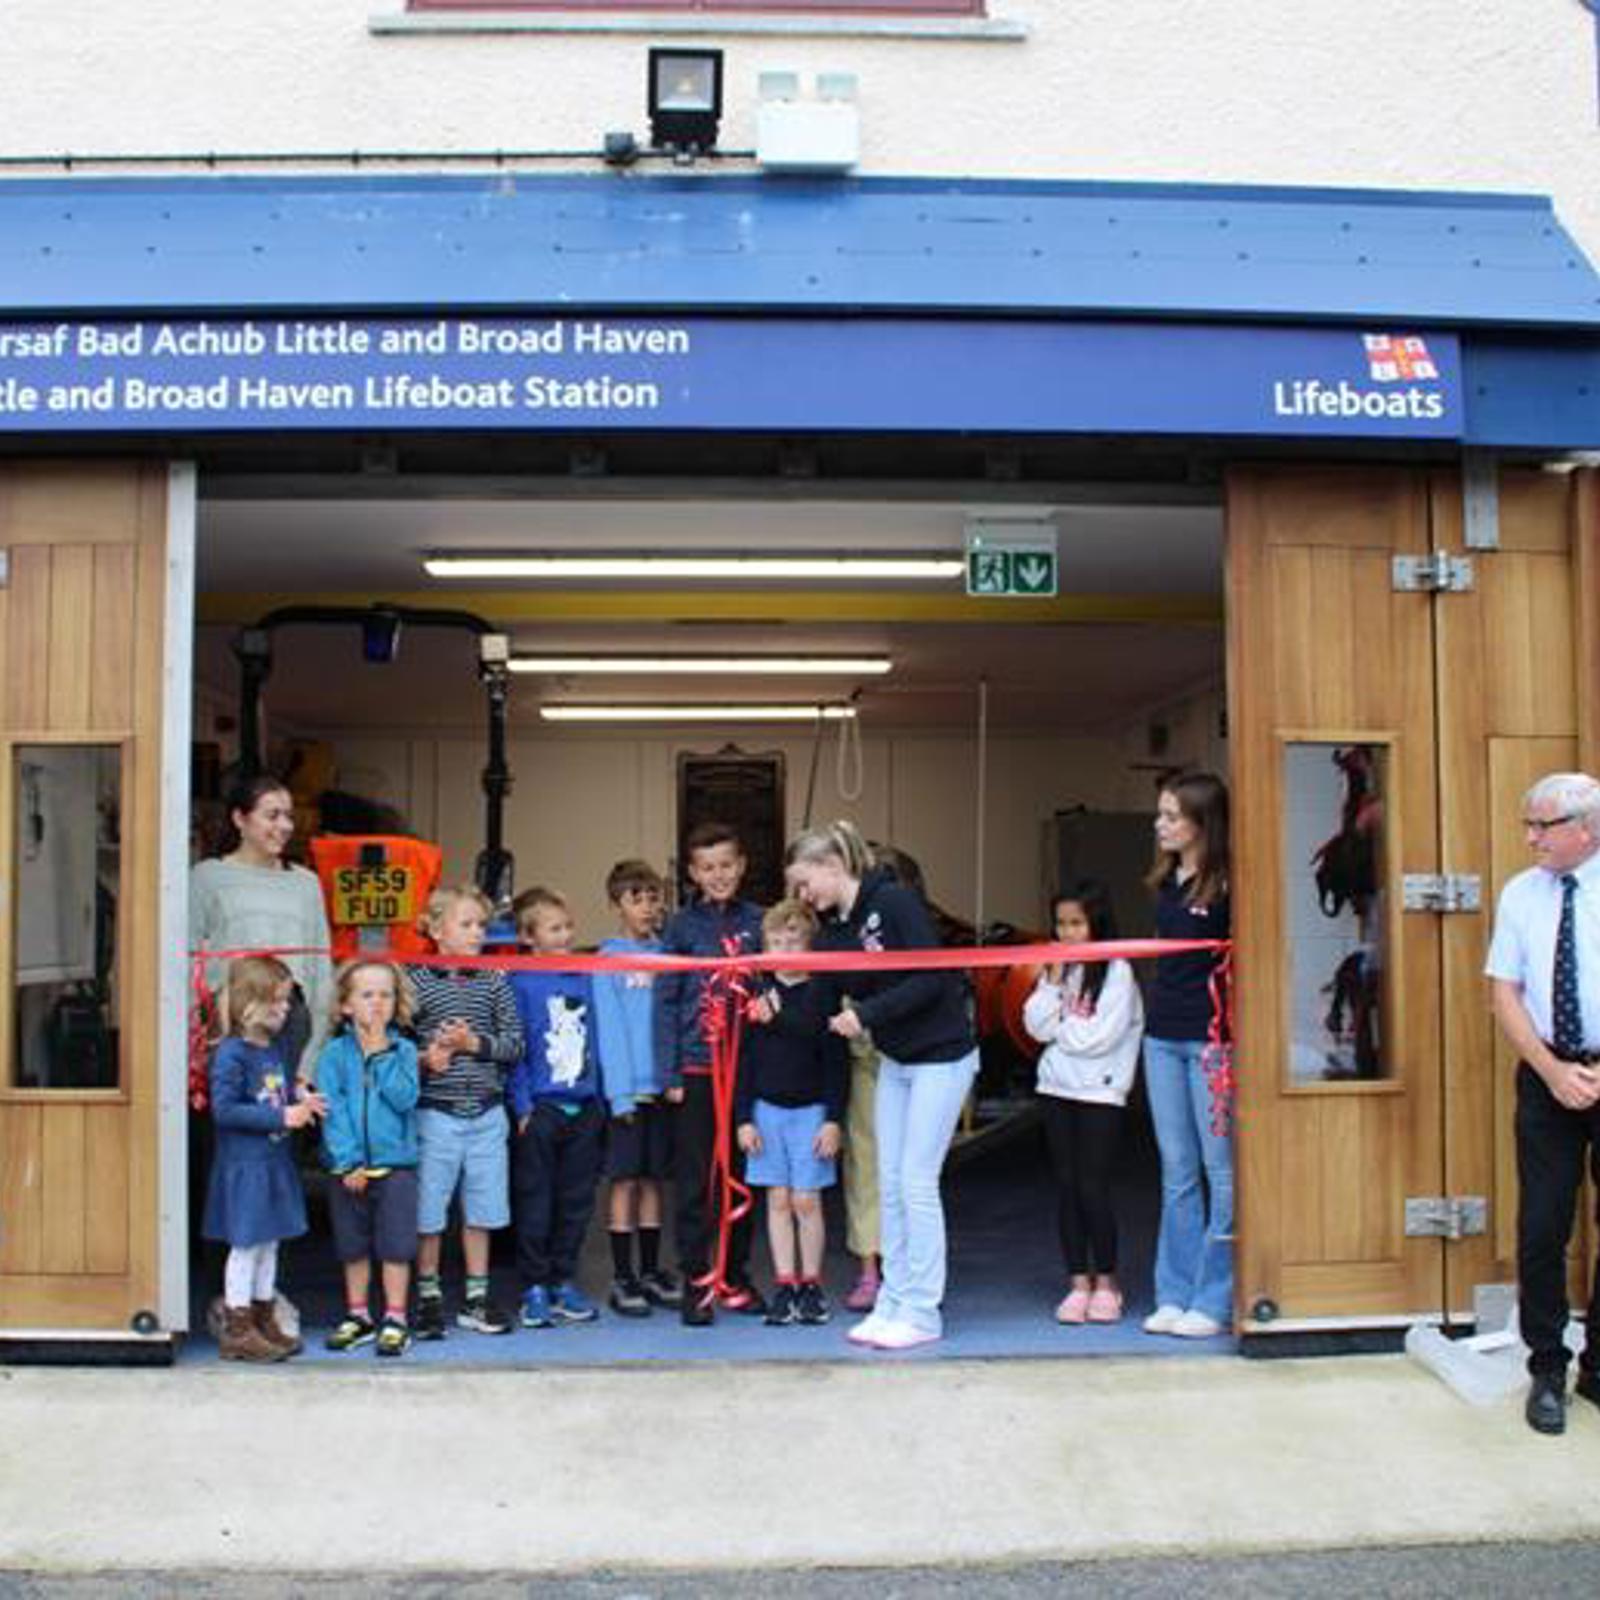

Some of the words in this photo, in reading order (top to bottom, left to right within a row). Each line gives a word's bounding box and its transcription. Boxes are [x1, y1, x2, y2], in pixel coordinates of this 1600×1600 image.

[0, 325, 67, 356] rsaf
[77, 325, 142, 356] Bad
[152, 324, 265, 355] Achub
[276, 322, 369, 354] Little
[380, 322, 446, 353] and
[459, 322, 562, 353] Broad
[575, 323, 688, 353] Haven
[47, 377, 114, 410] and
[124, 376, 229, 409] Broad
[239, 378, 353, 408] Haven
[365, 375, 514, 408] Lifeboat
[525, 376, 658, 408] Station
[1274, 380, 1443, 418] Lifeboats
